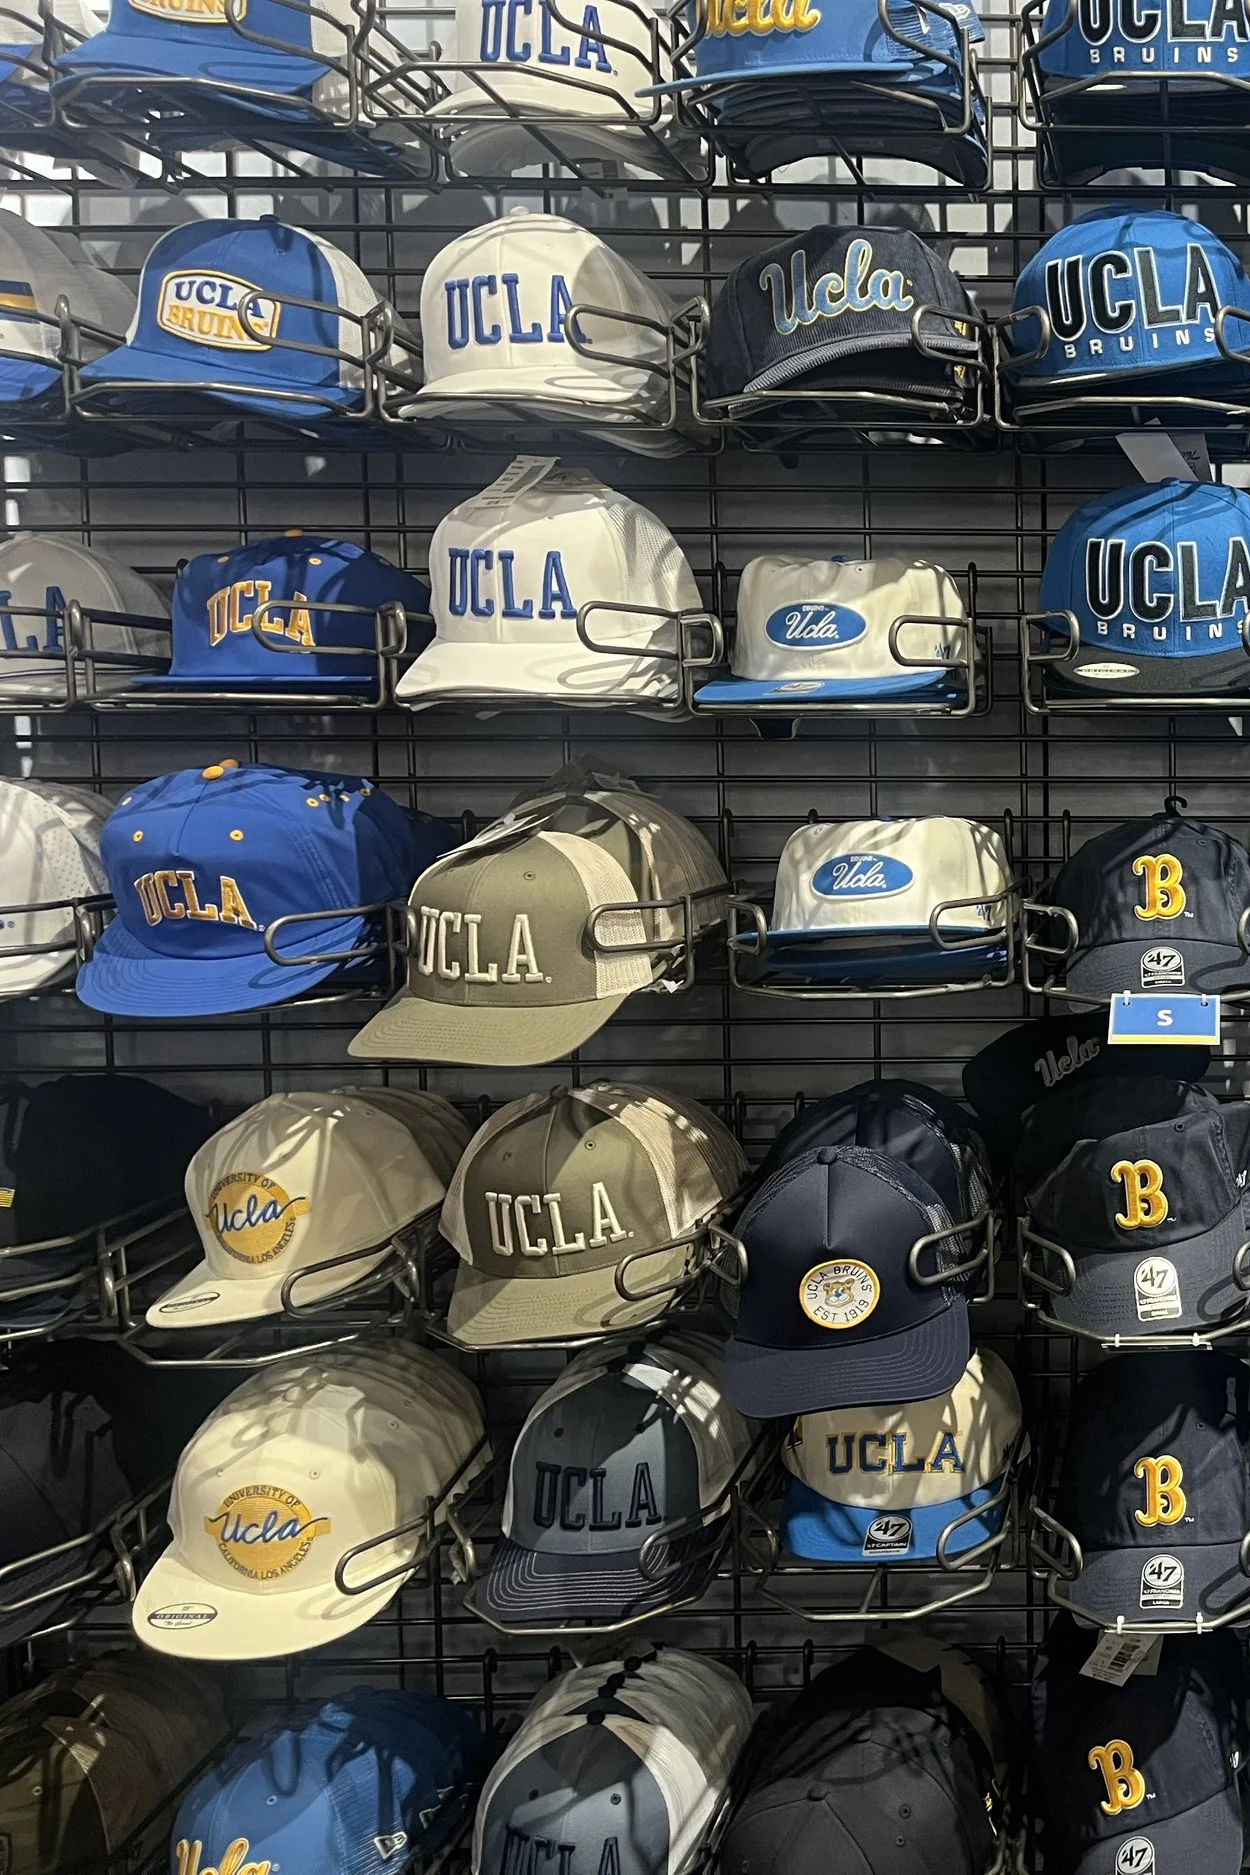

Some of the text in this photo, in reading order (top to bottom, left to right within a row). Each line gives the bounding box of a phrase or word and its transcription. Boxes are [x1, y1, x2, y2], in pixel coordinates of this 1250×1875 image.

[480, 0, 616, 73] UCLA
[1077, 0, 1250, 44] UCLA
[1089, 48, 1240, 63] BRUINS
[174, 278, 266, 318] UCLA
[760, 238, 914, 335] Ucla
[1045, 244, 1224, 341] UCLA
[444, 273, 588, 350] UCLA
[1065, 326, 1217, 358] BRUINS
[448, 547, 578, 620] UCLA
[207, 580, 316, 647] UCLA
[785, 611, 840, 639] Ucla
[1096, 619, 1245, 641] BRUINS
[832, 861, 887, 889] Ucla
[1132, 852, 1187, 922] B
[134, 869, 258, 931] UCLA
[418, 905, 547, 984] UCLA
[1156, 1008, 1173, 1027] S
[1034, 1035, 1101, 1087] Ucla
[262, 1177, 276, 1191] OF
[1110, 1159, 1169, 1231] B
[205, 1197, 306, 1233] Ucla
[485, 1181, 629, 1258] UCLA
[806, 1265, 872, 1301] UCLA BRUINS
[813, 1299, 870, 1324] EST 1919
[826, 1430, 965, 1475] UCLA
[222, 1485, 301, 1509] UNIVERSITY OF
[534, 1460, 664, 1531] UCLA
[1134, 1454, 1187, 1528] B
[208, 1510, 330, 1545] Ucla
[217, 1540, 313, 1580] CALIFORNIA LOS ANGELES
[1088, 1738, 1146, 1816] B
